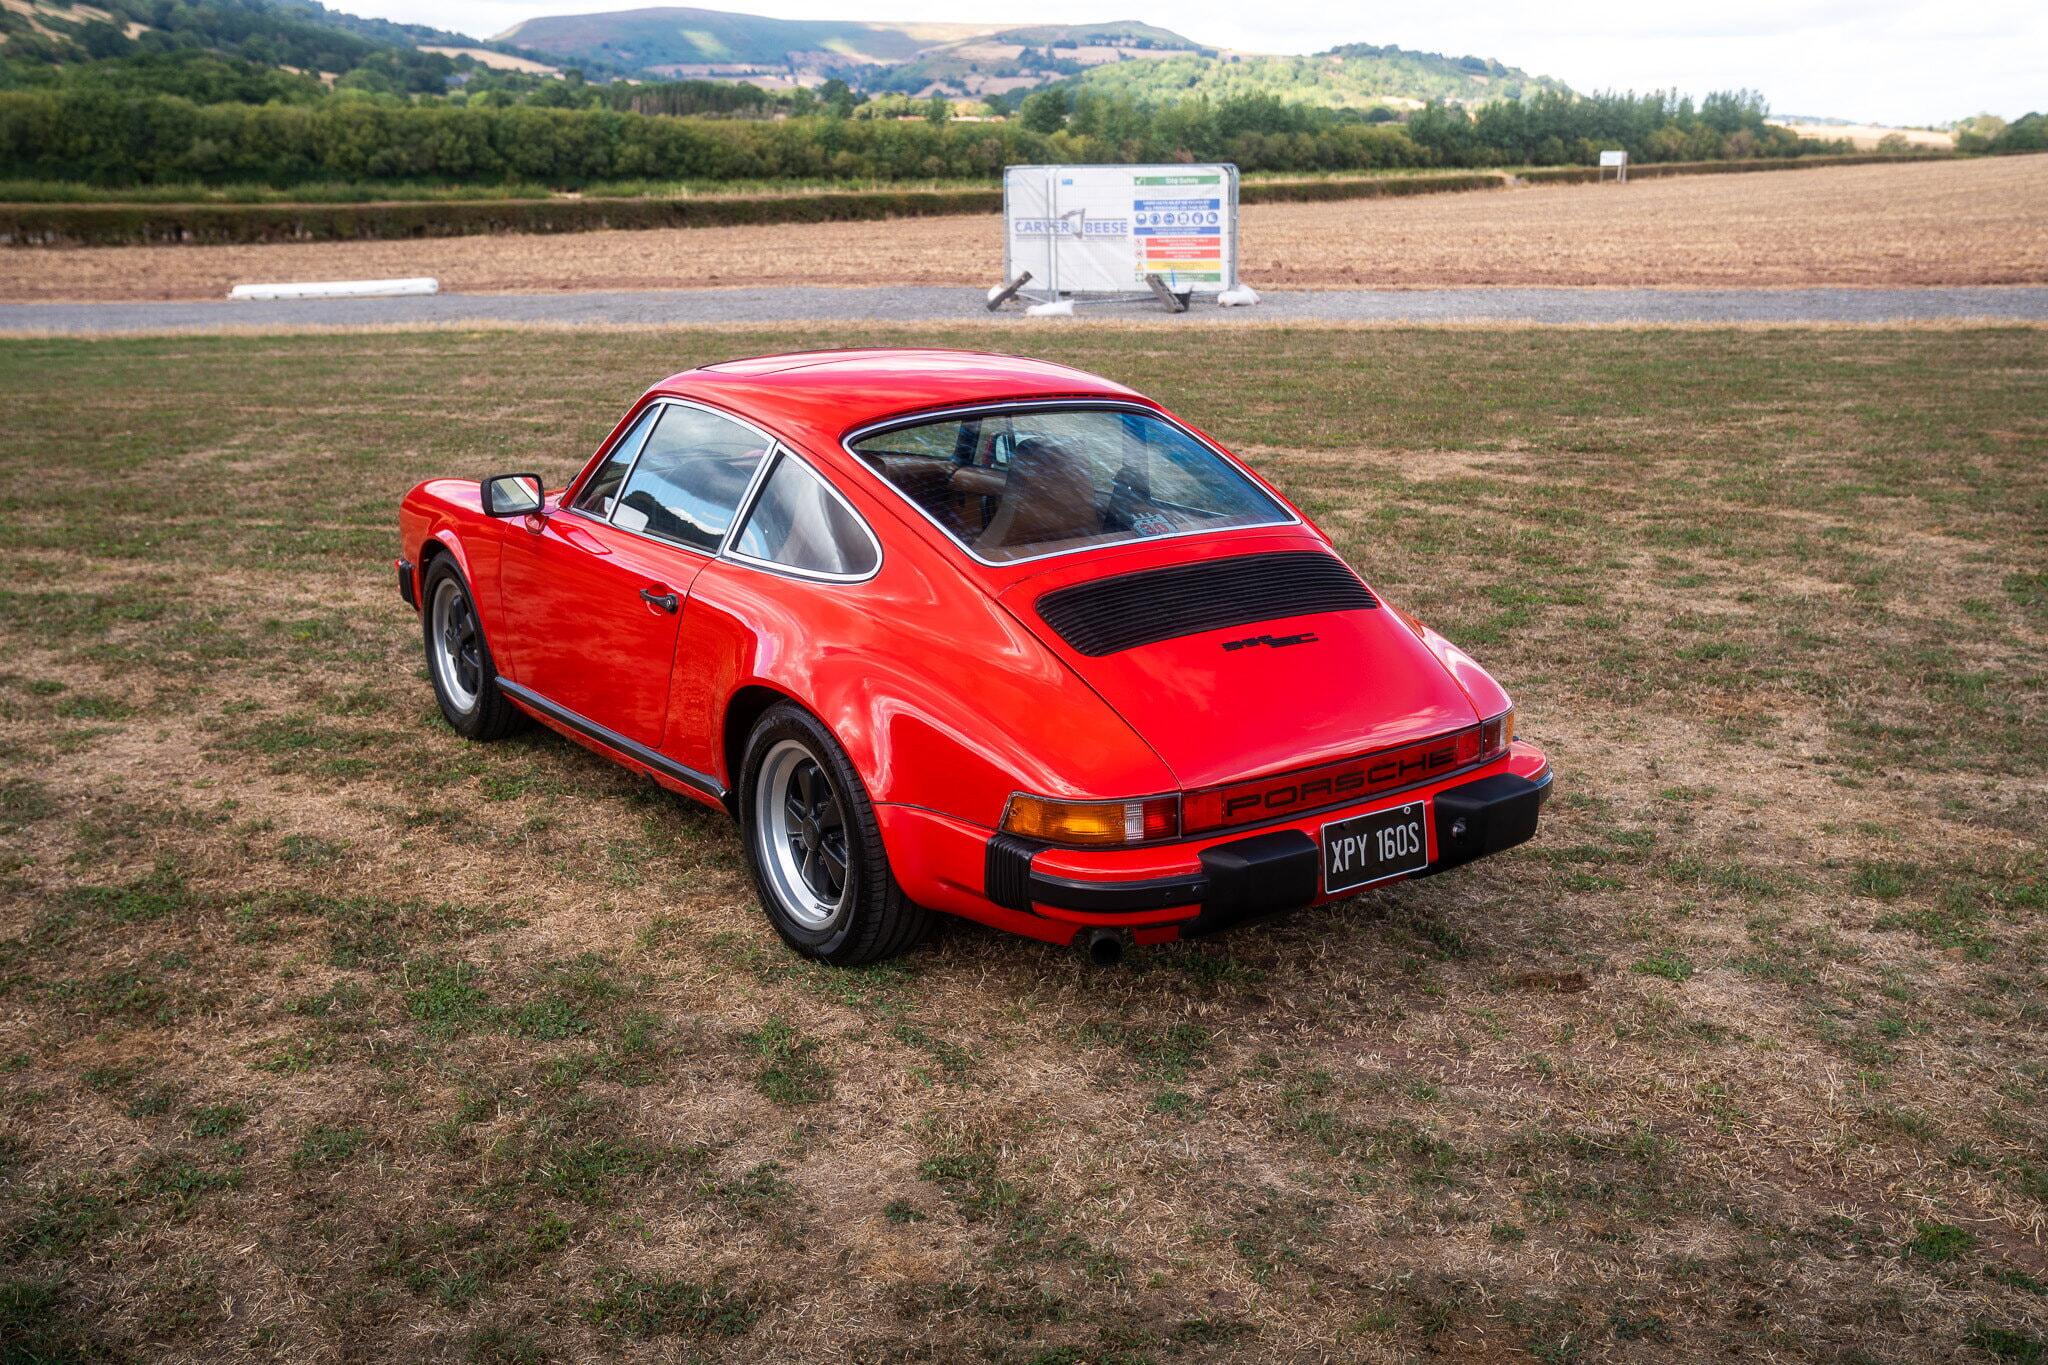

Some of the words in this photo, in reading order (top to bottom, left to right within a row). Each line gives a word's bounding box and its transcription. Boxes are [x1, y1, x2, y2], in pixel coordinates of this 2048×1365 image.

[1084, 222, 1128, 234] BEESE
[1227, 748, 1455, 816] PORSCHE
[1331, 834, 1368, 874] XPY
[1376, 822, 1420, 862] 160S
